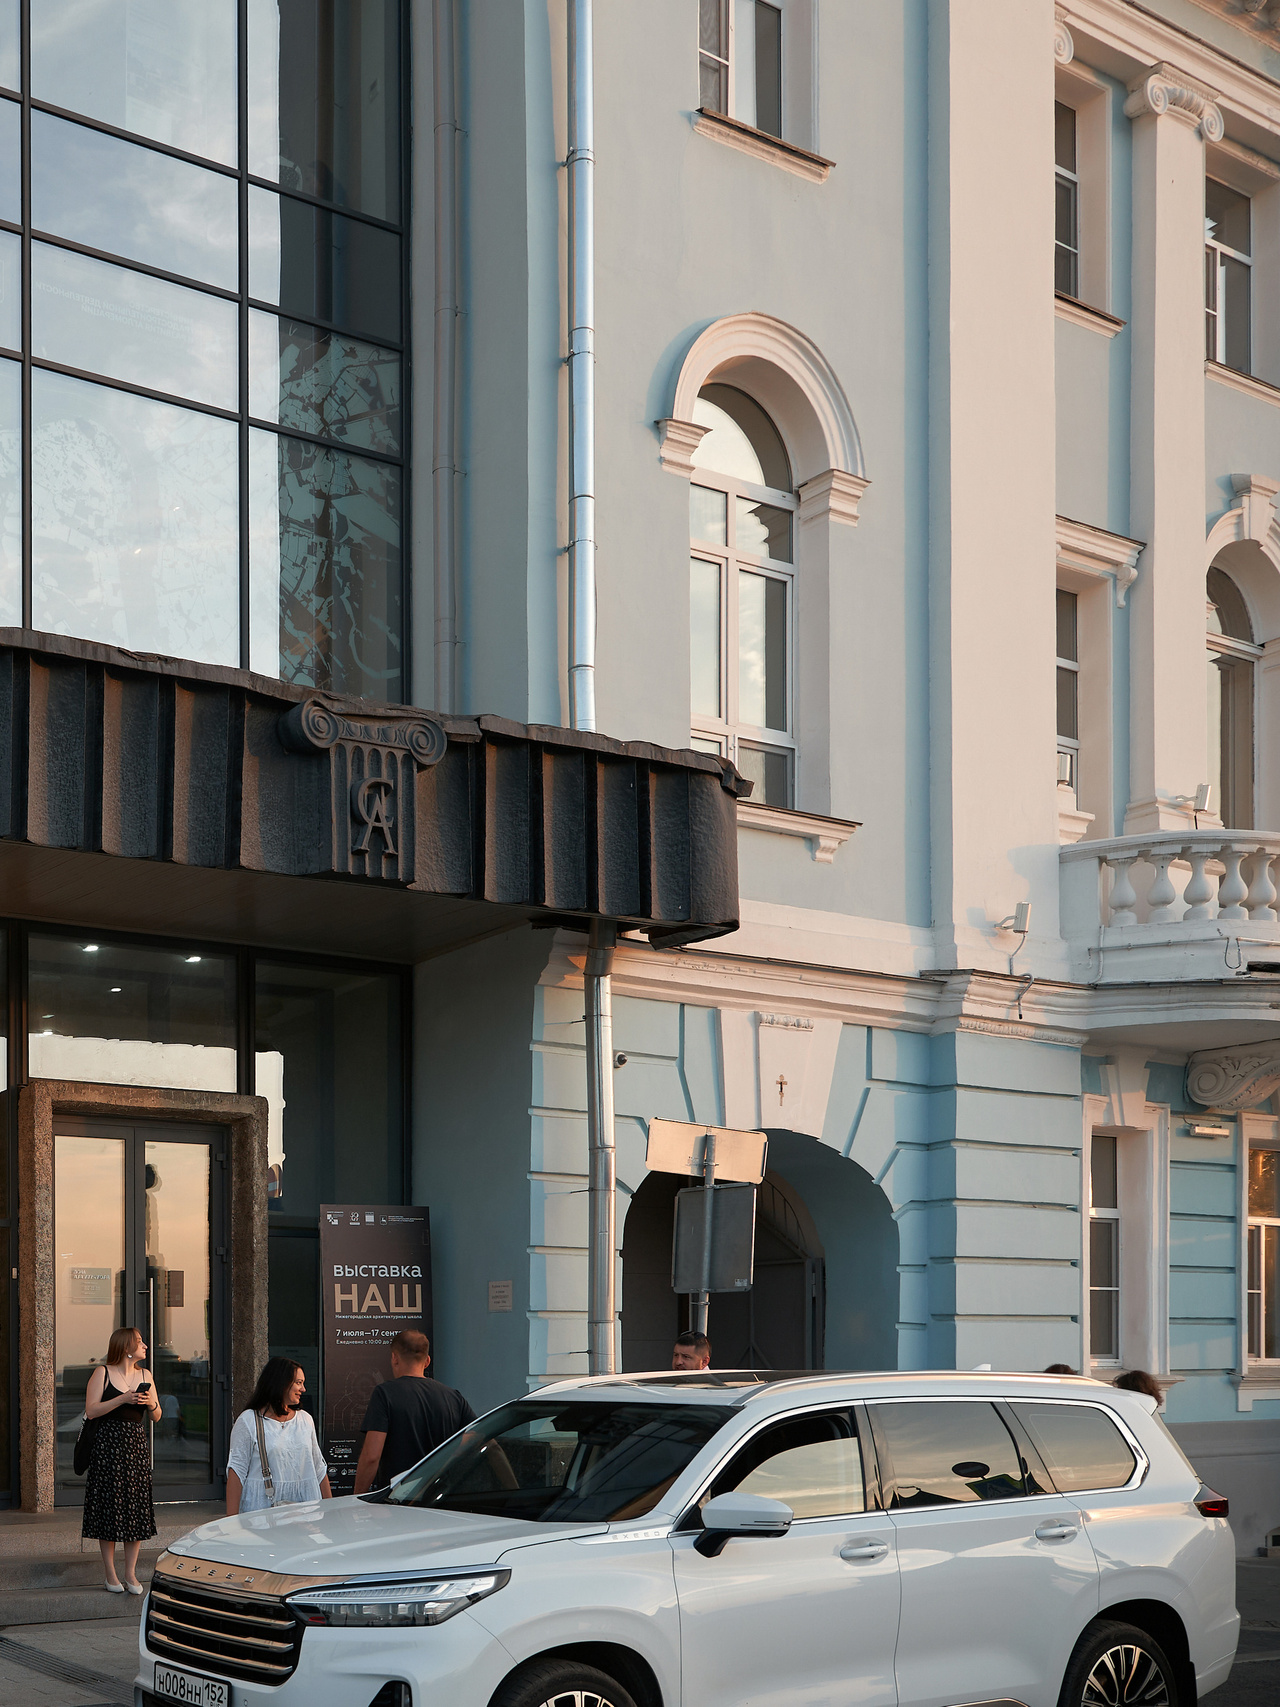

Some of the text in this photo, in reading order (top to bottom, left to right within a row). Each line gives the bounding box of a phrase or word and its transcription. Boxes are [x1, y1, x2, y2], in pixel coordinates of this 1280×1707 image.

[334, 1283, 422, 1313] НАШ
[336, 1329, 341, 1337] 7
[612, 1531, 661, 1540] EXEED
[176, 1562, 255, 1583] EXEED
[204, 1682, 224, 1704] 152
